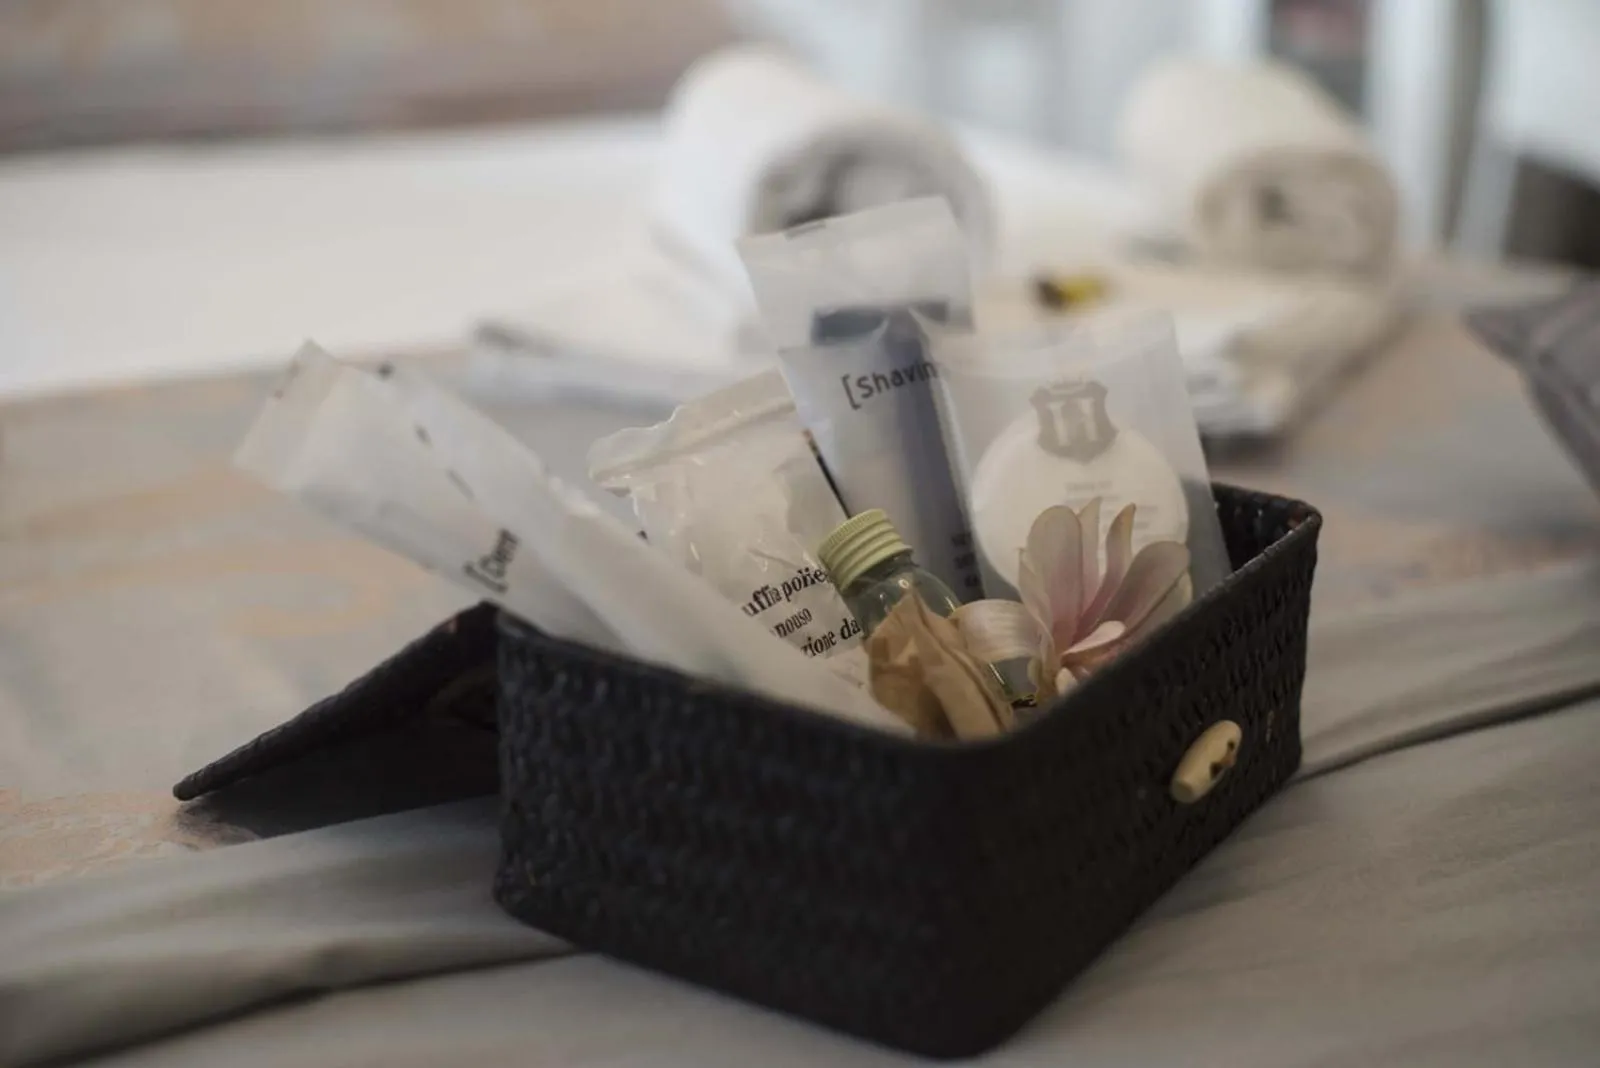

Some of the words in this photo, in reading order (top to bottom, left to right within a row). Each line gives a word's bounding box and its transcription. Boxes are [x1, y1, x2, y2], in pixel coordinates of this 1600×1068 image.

[781, 567, 830, 602] polie
[770, 608, 813, 638] nouso
[840, 618, 861, 640] da
